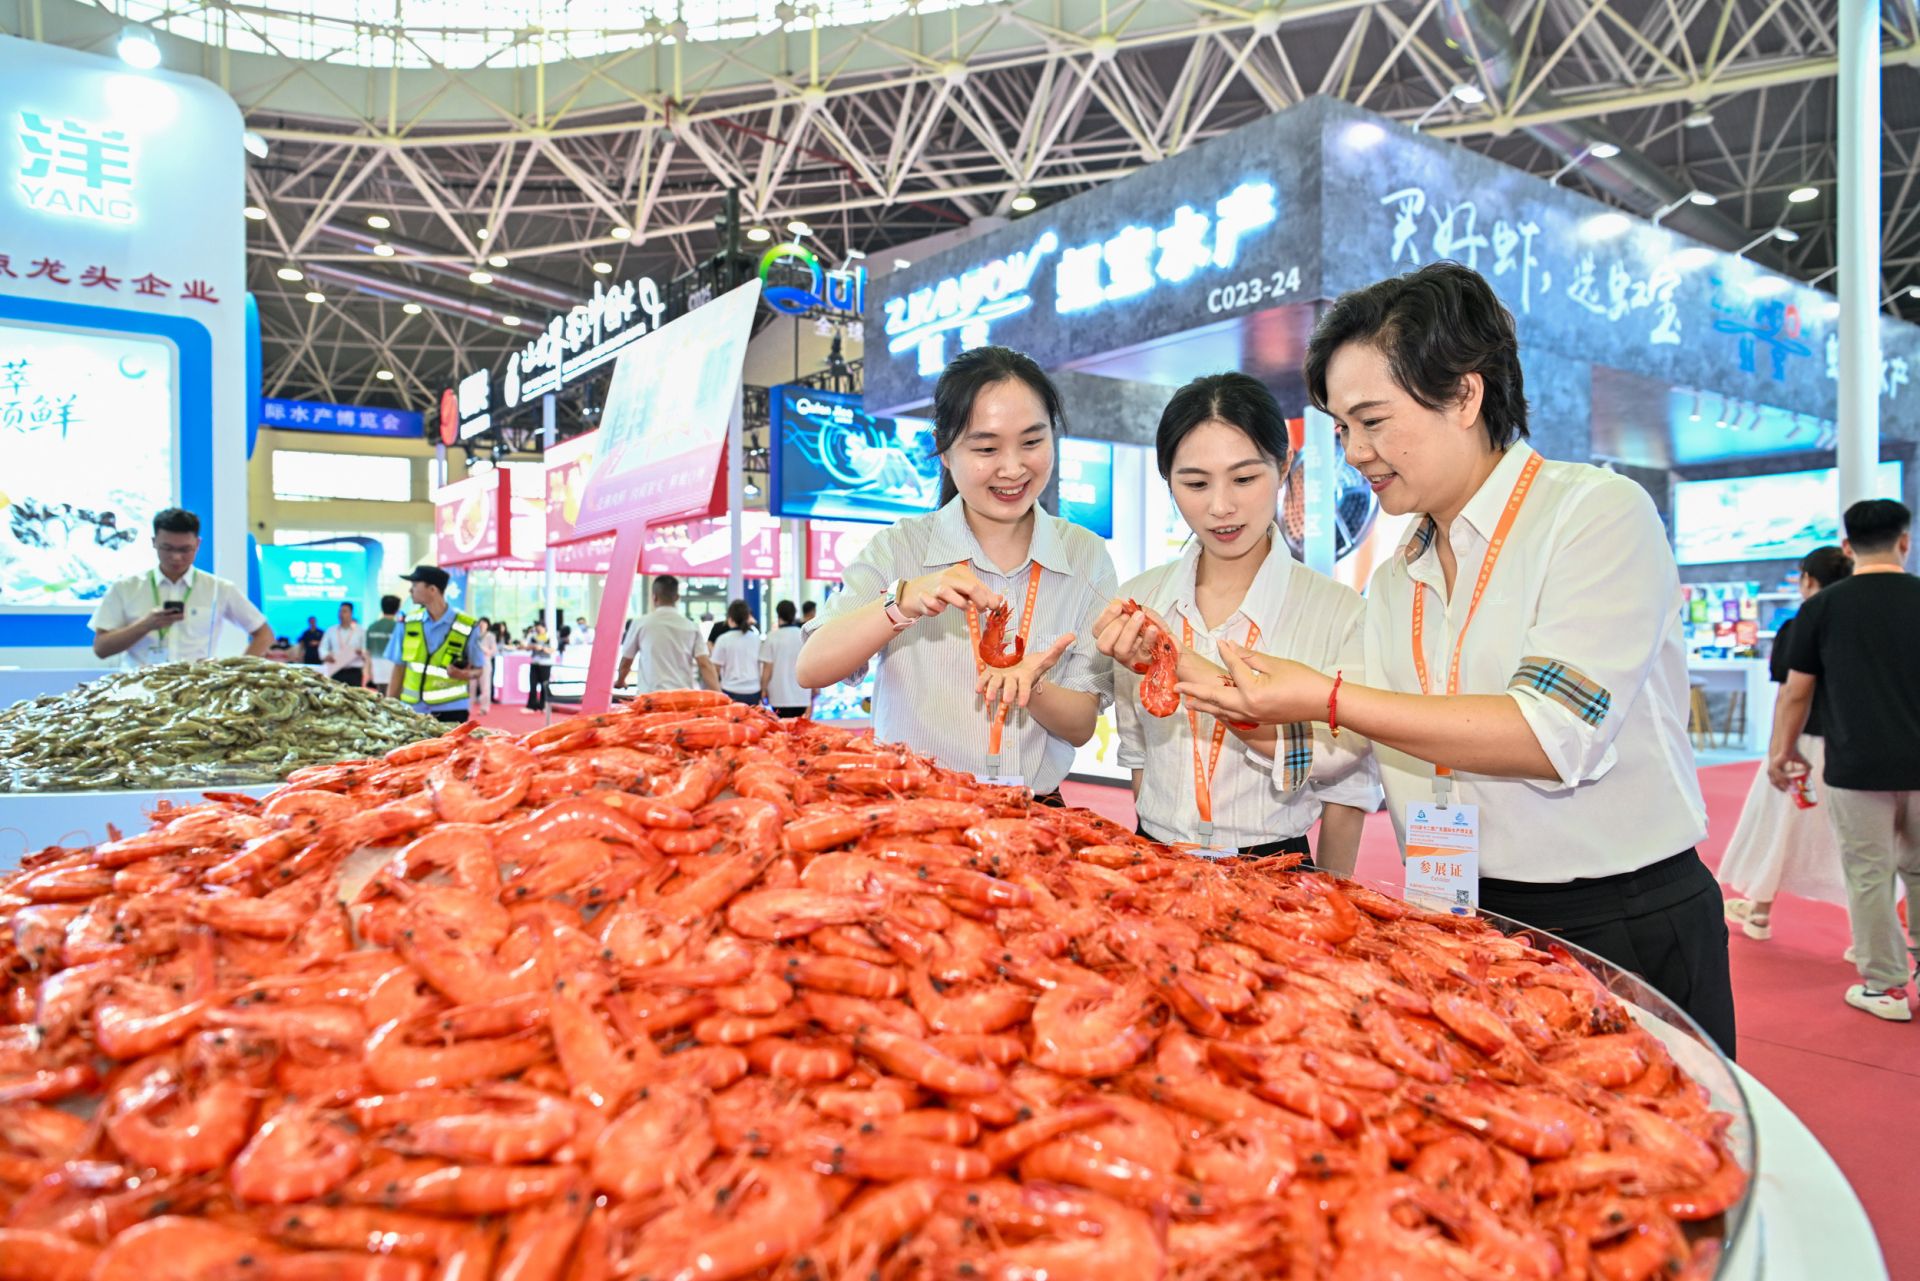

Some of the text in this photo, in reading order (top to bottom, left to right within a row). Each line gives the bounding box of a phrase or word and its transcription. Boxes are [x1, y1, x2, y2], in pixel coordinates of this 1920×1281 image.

[20, 110, 132, 190] 洋
[20, 182, 133, 220] YANG
[1207, 265, 1302, 314] C023-24
[264, 402, 401, 431] 际水产博览会
[1420, 860, 1463, 877] 参展证
